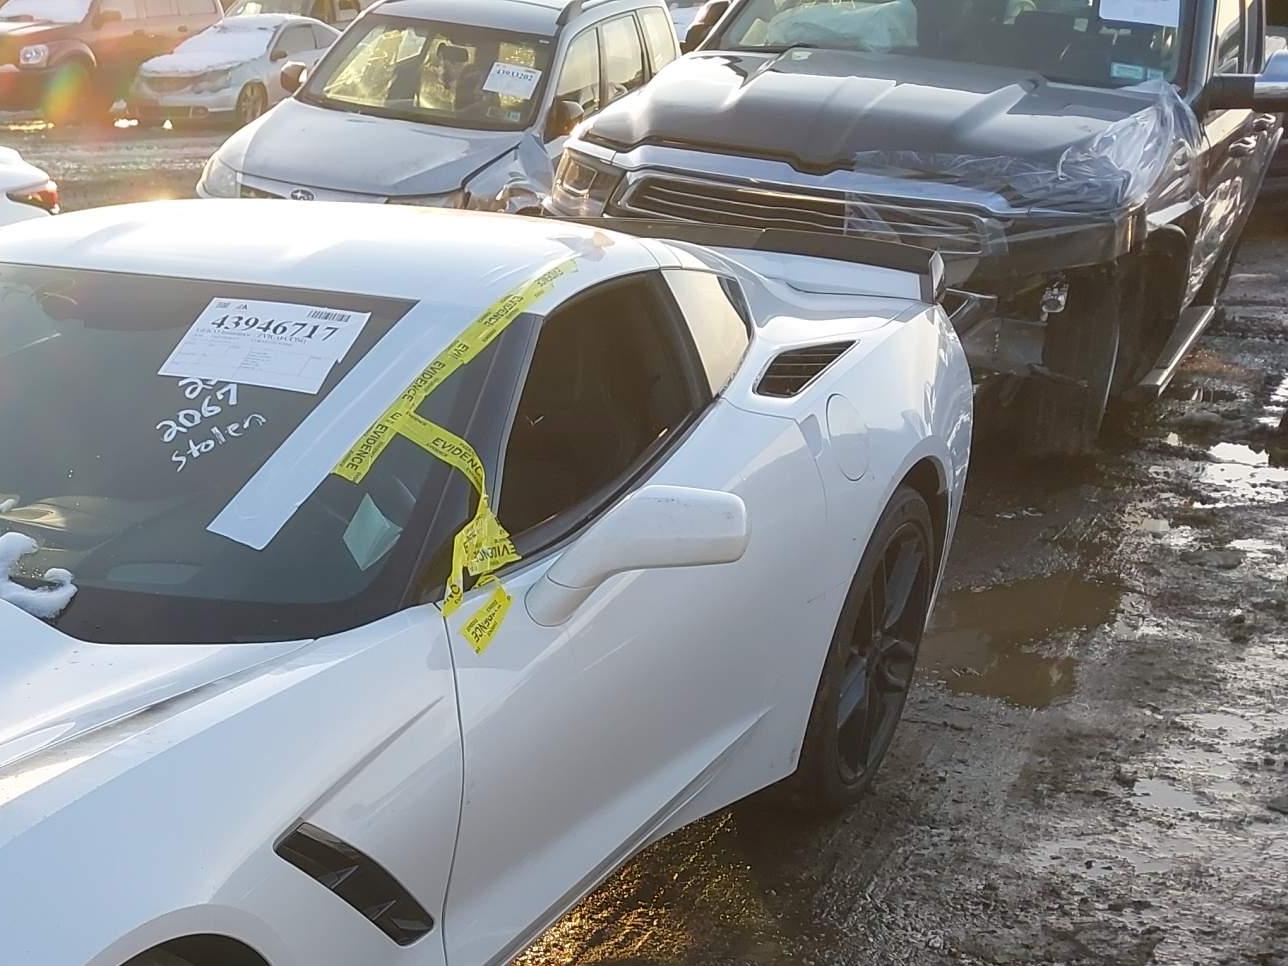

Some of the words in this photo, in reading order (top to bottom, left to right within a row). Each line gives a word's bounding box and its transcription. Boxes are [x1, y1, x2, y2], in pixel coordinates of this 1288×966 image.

[211, 314, 340, 342] 43946717
[401, 359, 447, 402] EVIDENCE
[156, 383, 238, 442] 2067
[346, 423, 389, 471] EVIDENCE
[431, 437, 483, 480] EVIDENC
